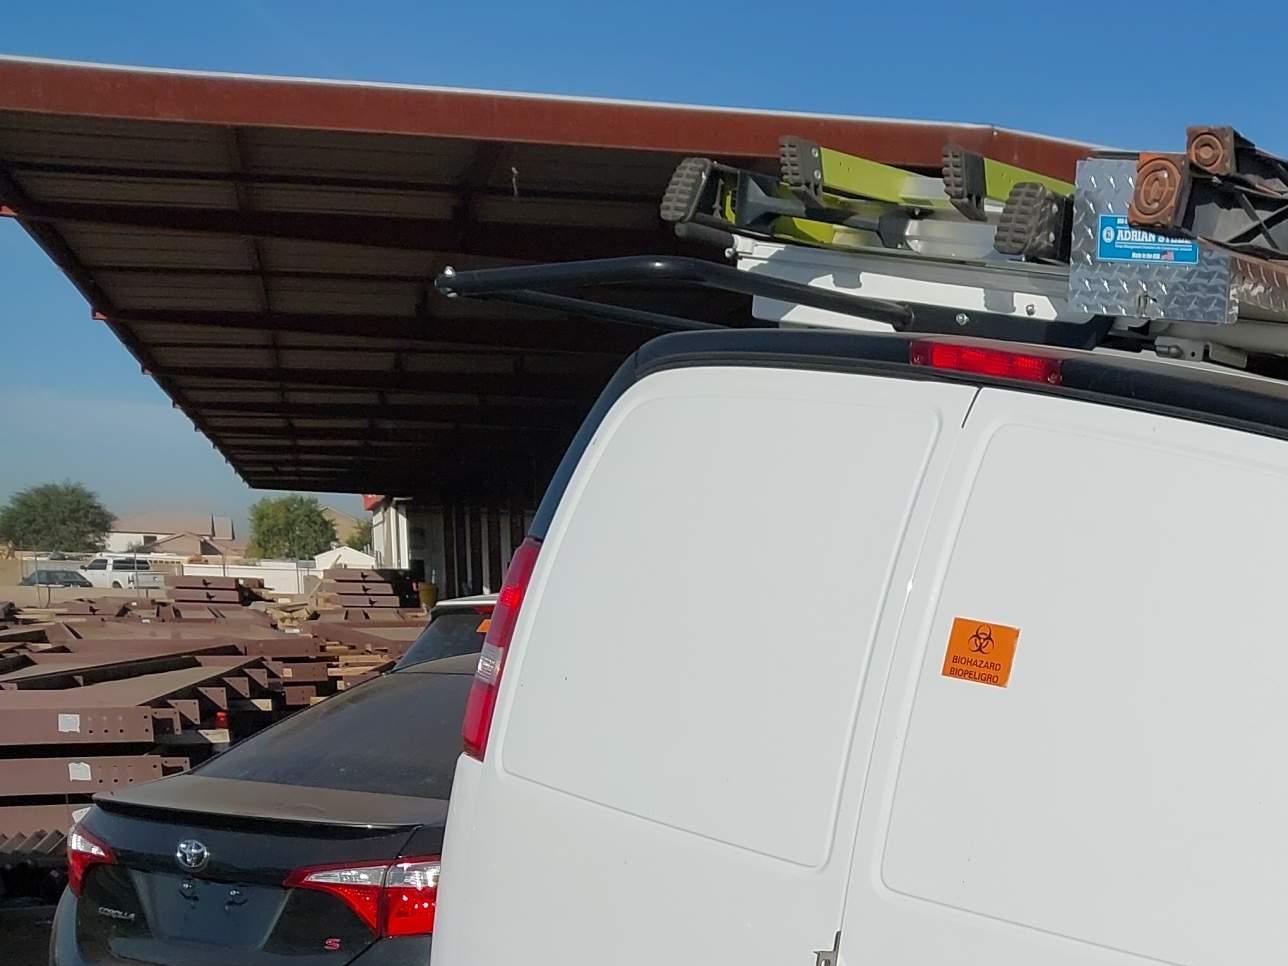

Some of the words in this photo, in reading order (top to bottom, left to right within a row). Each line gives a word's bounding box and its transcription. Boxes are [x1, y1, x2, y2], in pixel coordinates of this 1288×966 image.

[1116, 229, 1156, 242] ADRIAN
[952, 655, 1002, 672] BIOHAZARD
[949, 667, 999, 684] BIOPELIGRO
